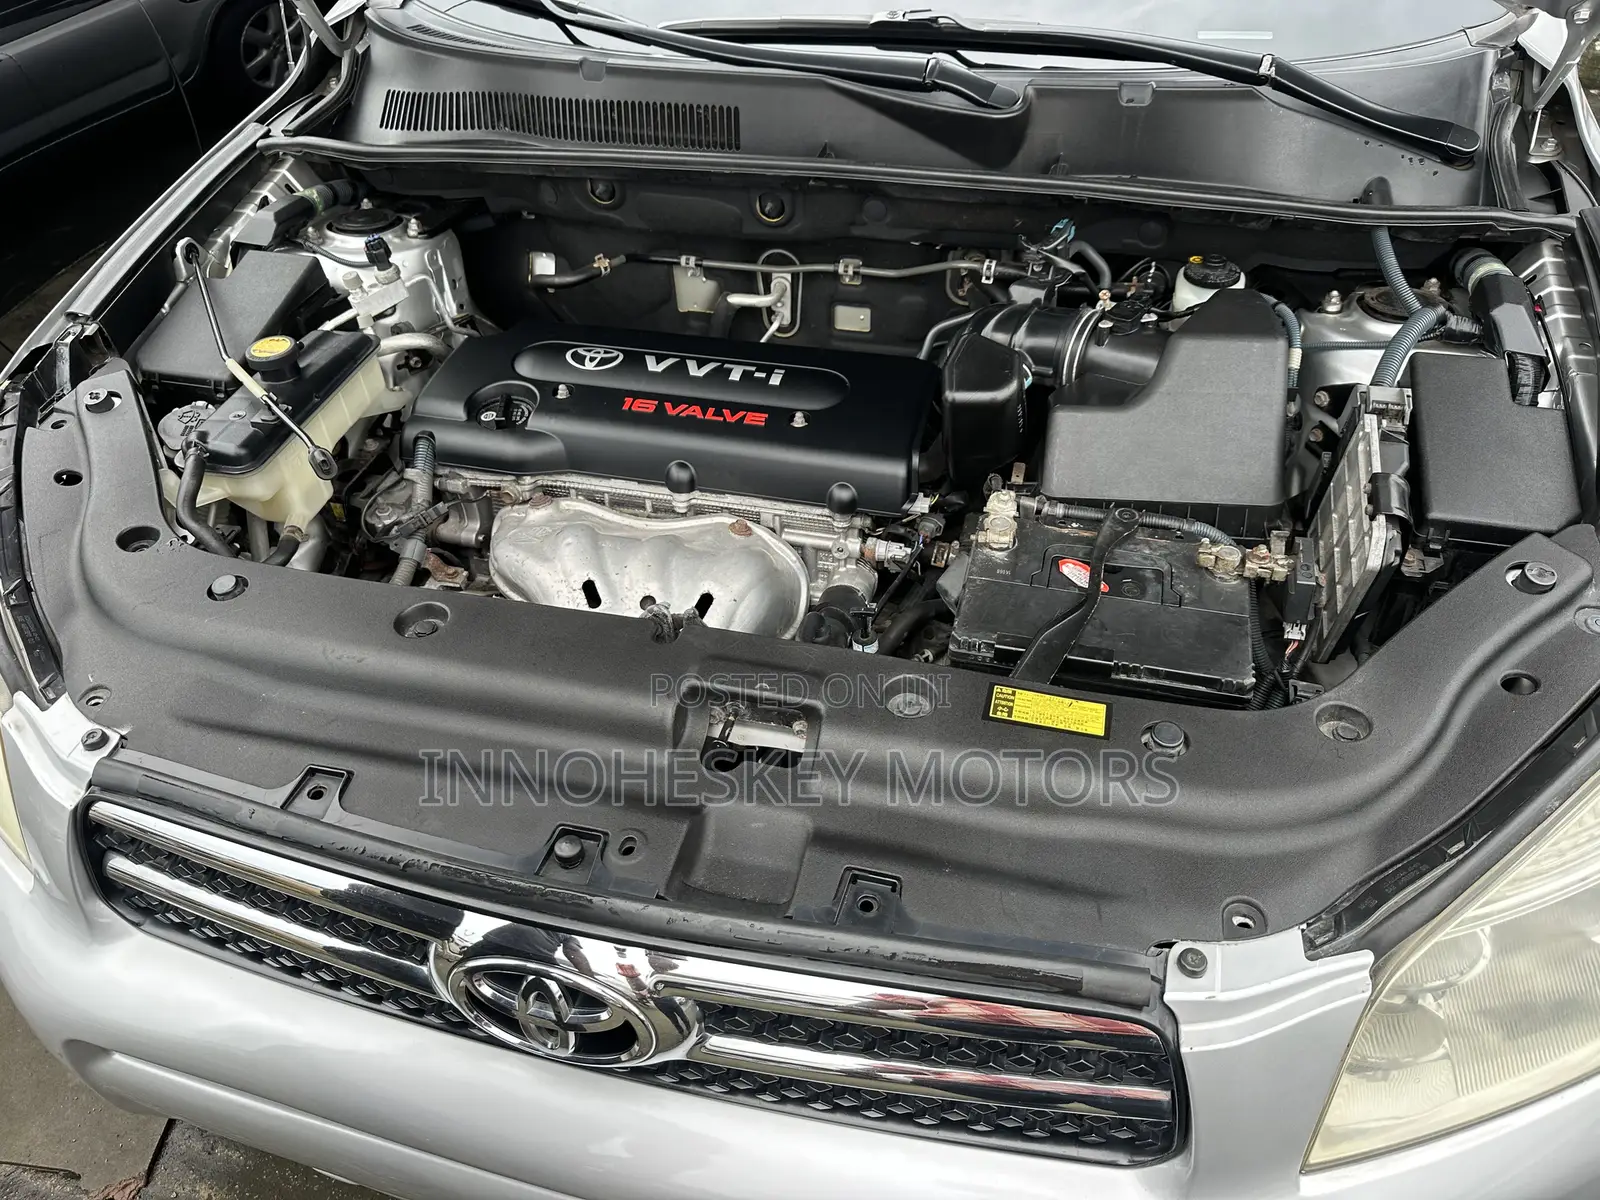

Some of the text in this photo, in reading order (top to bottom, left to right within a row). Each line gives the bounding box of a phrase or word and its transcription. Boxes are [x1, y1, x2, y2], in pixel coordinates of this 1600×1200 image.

[644, 354, 786, 386] VVT-i
[622, 397, 769, 427] 16 VALVE
